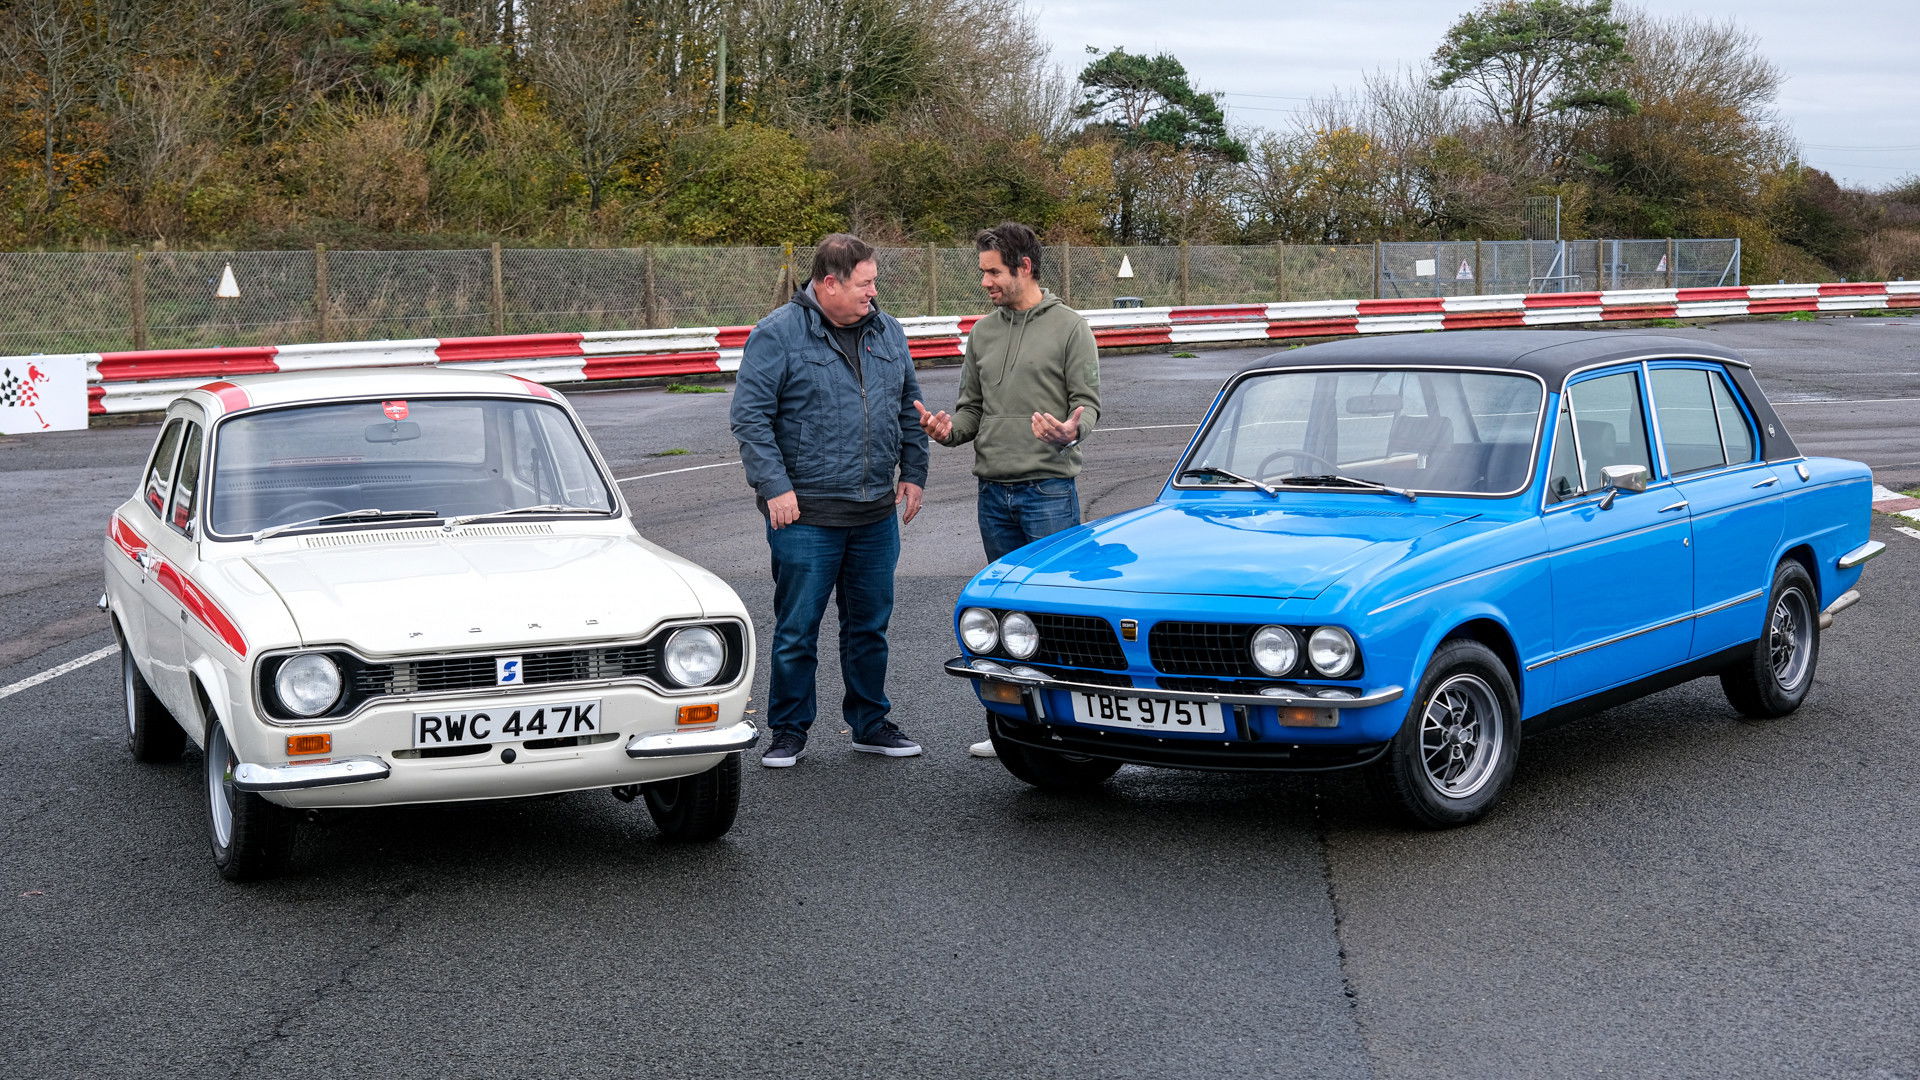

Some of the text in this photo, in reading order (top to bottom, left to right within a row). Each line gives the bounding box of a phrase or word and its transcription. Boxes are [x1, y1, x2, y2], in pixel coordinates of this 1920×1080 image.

[419, 704, 595, 743] RWC 447K
[1081, 693, 1209, 726] TBE 975T
